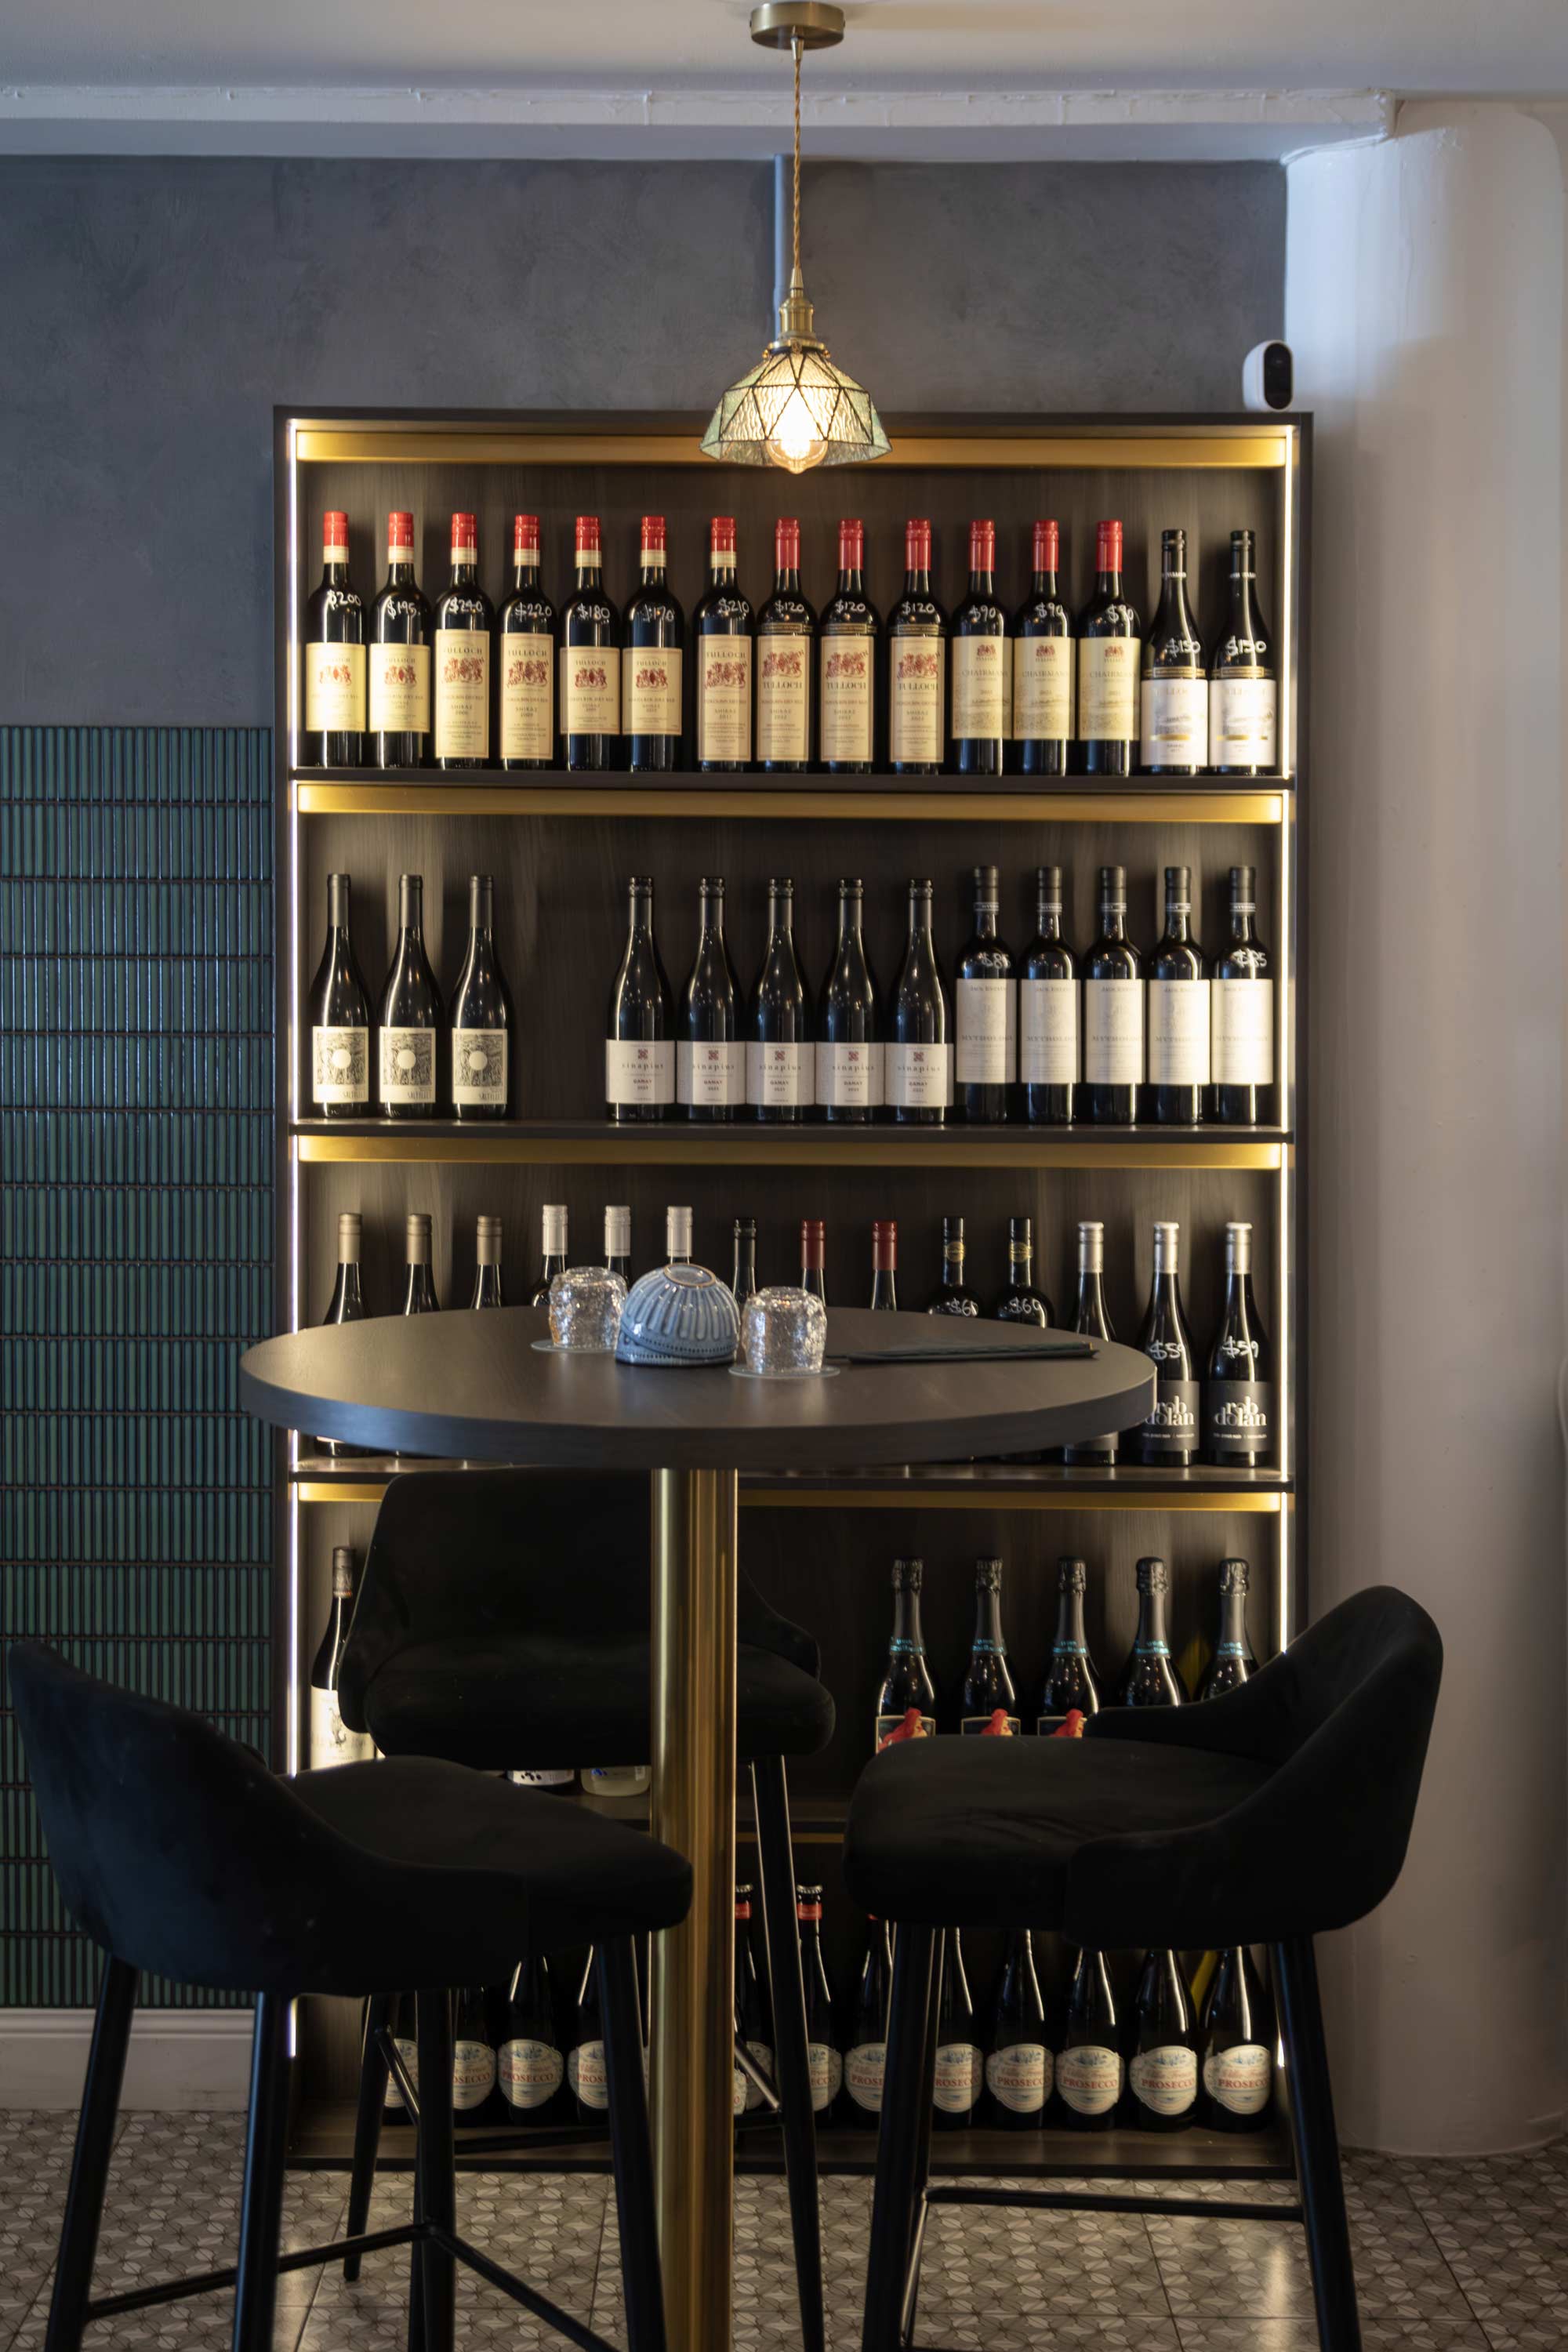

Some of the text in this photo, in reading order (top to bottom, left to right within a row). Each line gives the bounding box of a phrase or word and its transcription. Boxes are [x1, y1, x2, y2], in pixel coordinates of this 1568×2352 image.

[328, 590, 361, 610] $200
[718, 597, 750, 614] $210
[775, 600, 804, 614] $120
[835, 599, 866, 614] $120
[902, 601, 935, 615] $120
[387, 600, 417, 619] $195
[515, 602, 552, 622] $220
[577, 603, 611, 620] $180
[969, 604, 996, 622] $90
[1036, 602, 1063, 618] $90
[1222, 1335, 1259, 1359] $59
[1156, 1396, 1187, 1414] rob
[1225, 1396, 1259, 1415] rob
[1214, 1406, 1267, 1427] dolan
[453, 2072, 491, 2084] OSECCO
[503, 2070, 554, 2083] PROSECCO
[1063, 2077, 1117, 2089] PROSECCO
[1142, 2078, 1195, 2089] PROSECCO
